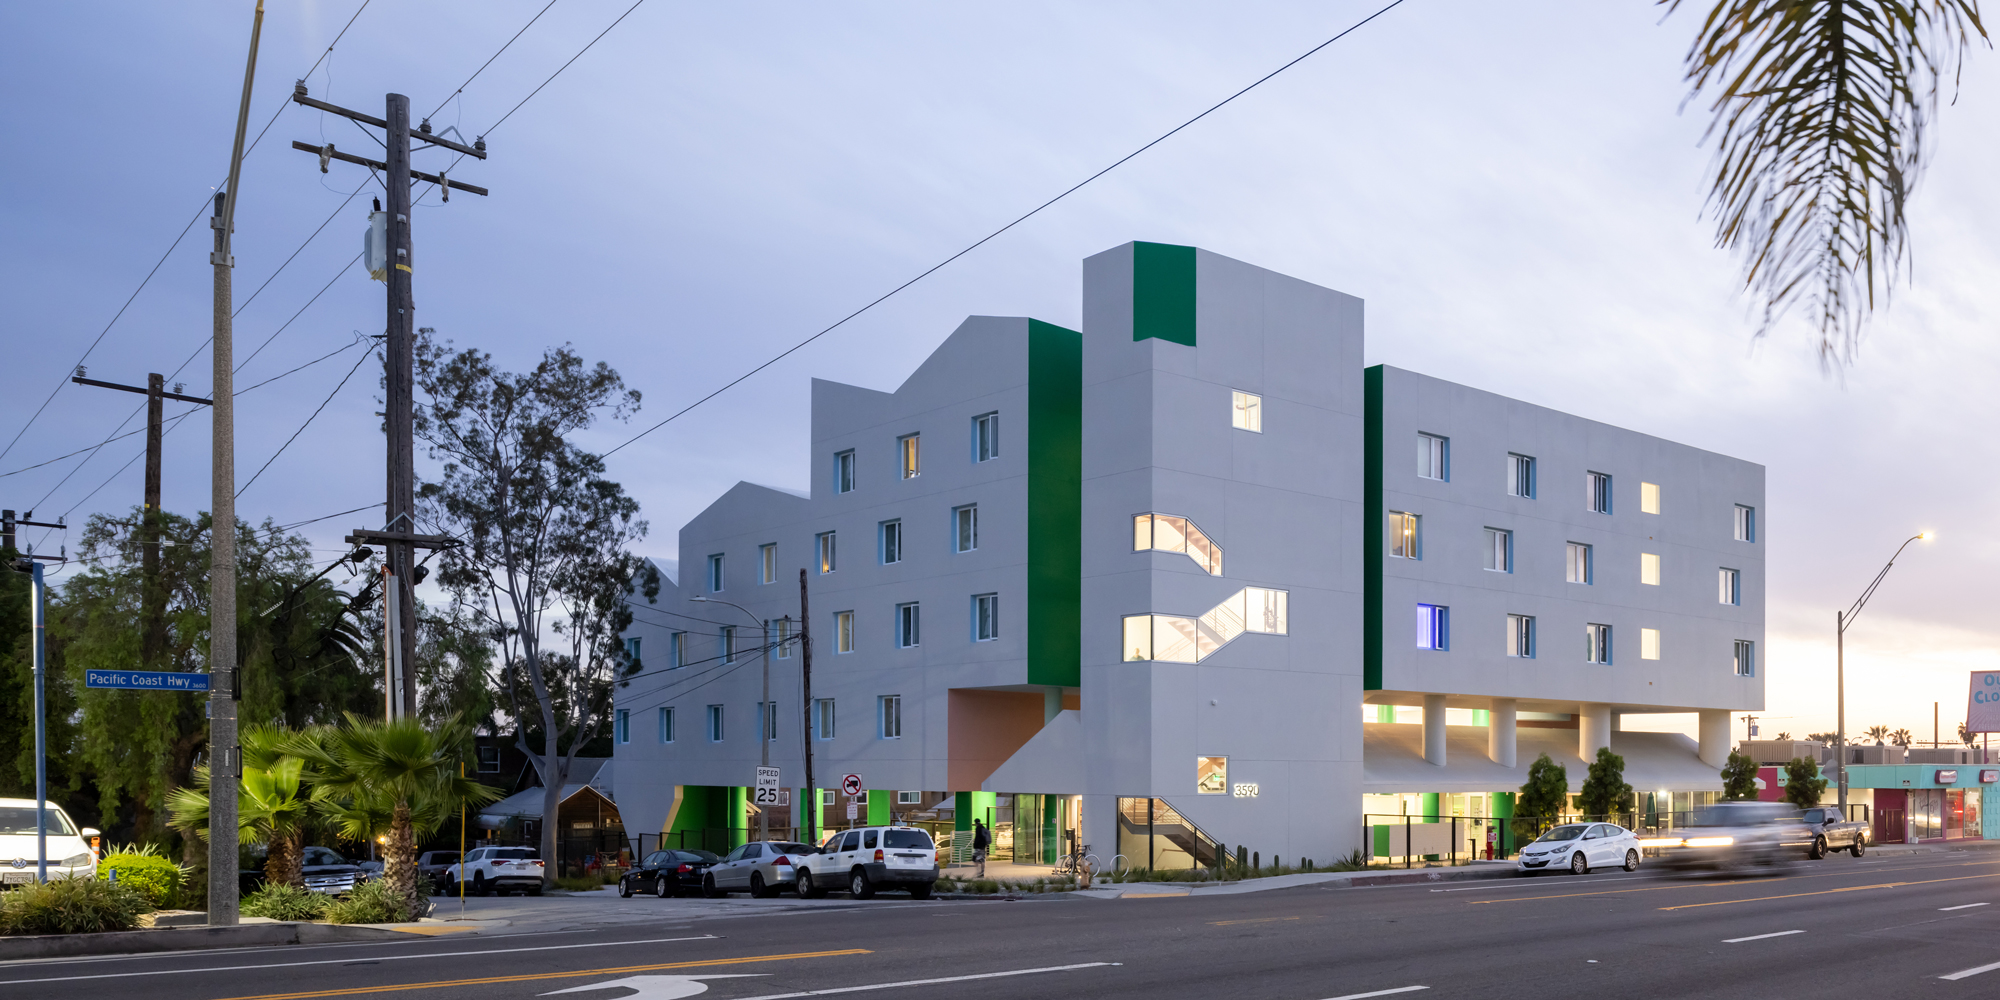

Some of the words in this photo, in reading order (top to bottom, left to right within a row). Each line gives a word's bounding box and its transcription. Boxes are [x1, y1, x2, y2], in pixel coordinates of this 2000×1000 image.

[89, 673, 127, 685] Pacific
[131, 674, 163, 686] Coast
[167, 676, 191, 689] Hwy
[1974, 690, 2000, 704] CLO
[758, 769, 779, 777] SPEED
[757, 788, 777, 802] 25
[1234, 784, 1260, 797] 3590
